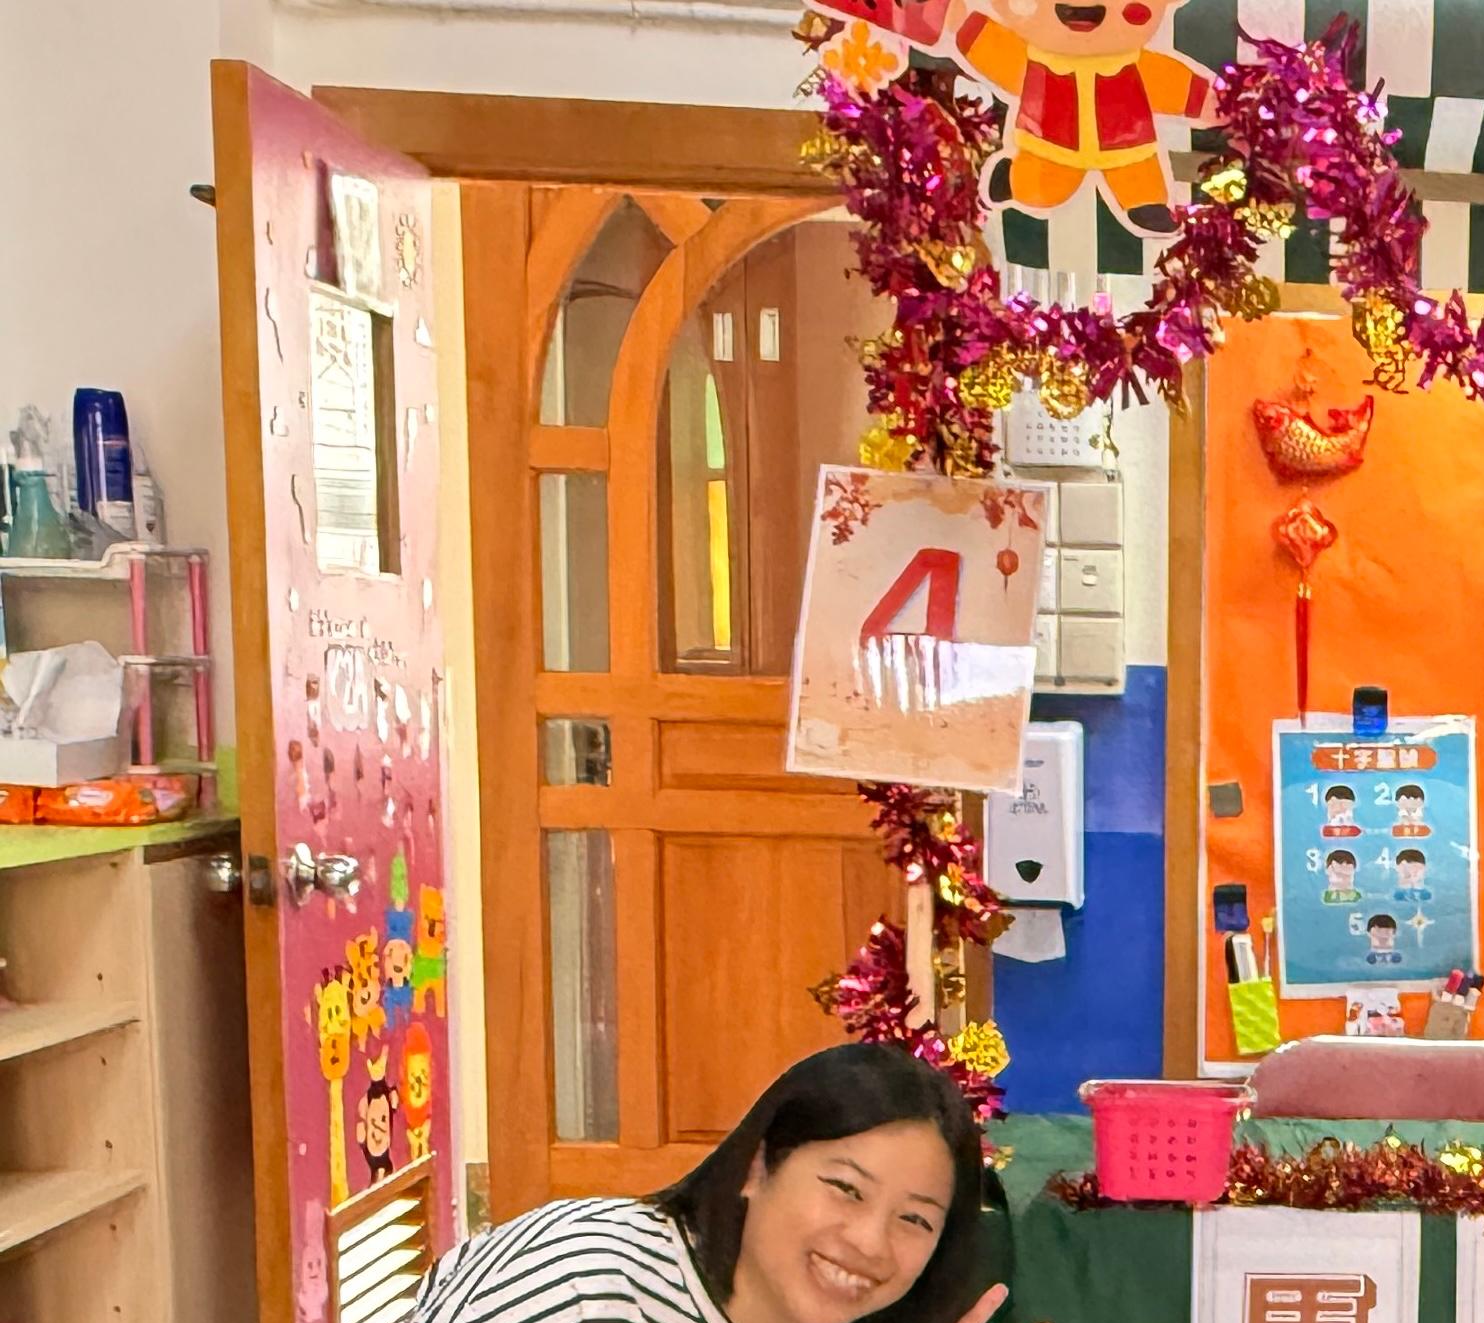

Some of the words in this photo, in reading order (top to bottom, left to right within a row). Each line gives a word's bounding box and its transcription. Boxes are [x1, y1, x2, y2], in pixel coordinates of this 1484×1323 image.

[1304, 783, 1319, 808] 1
[1374, 782, 1394, 806] 2
[1375, 847, 1391, 870] 4
